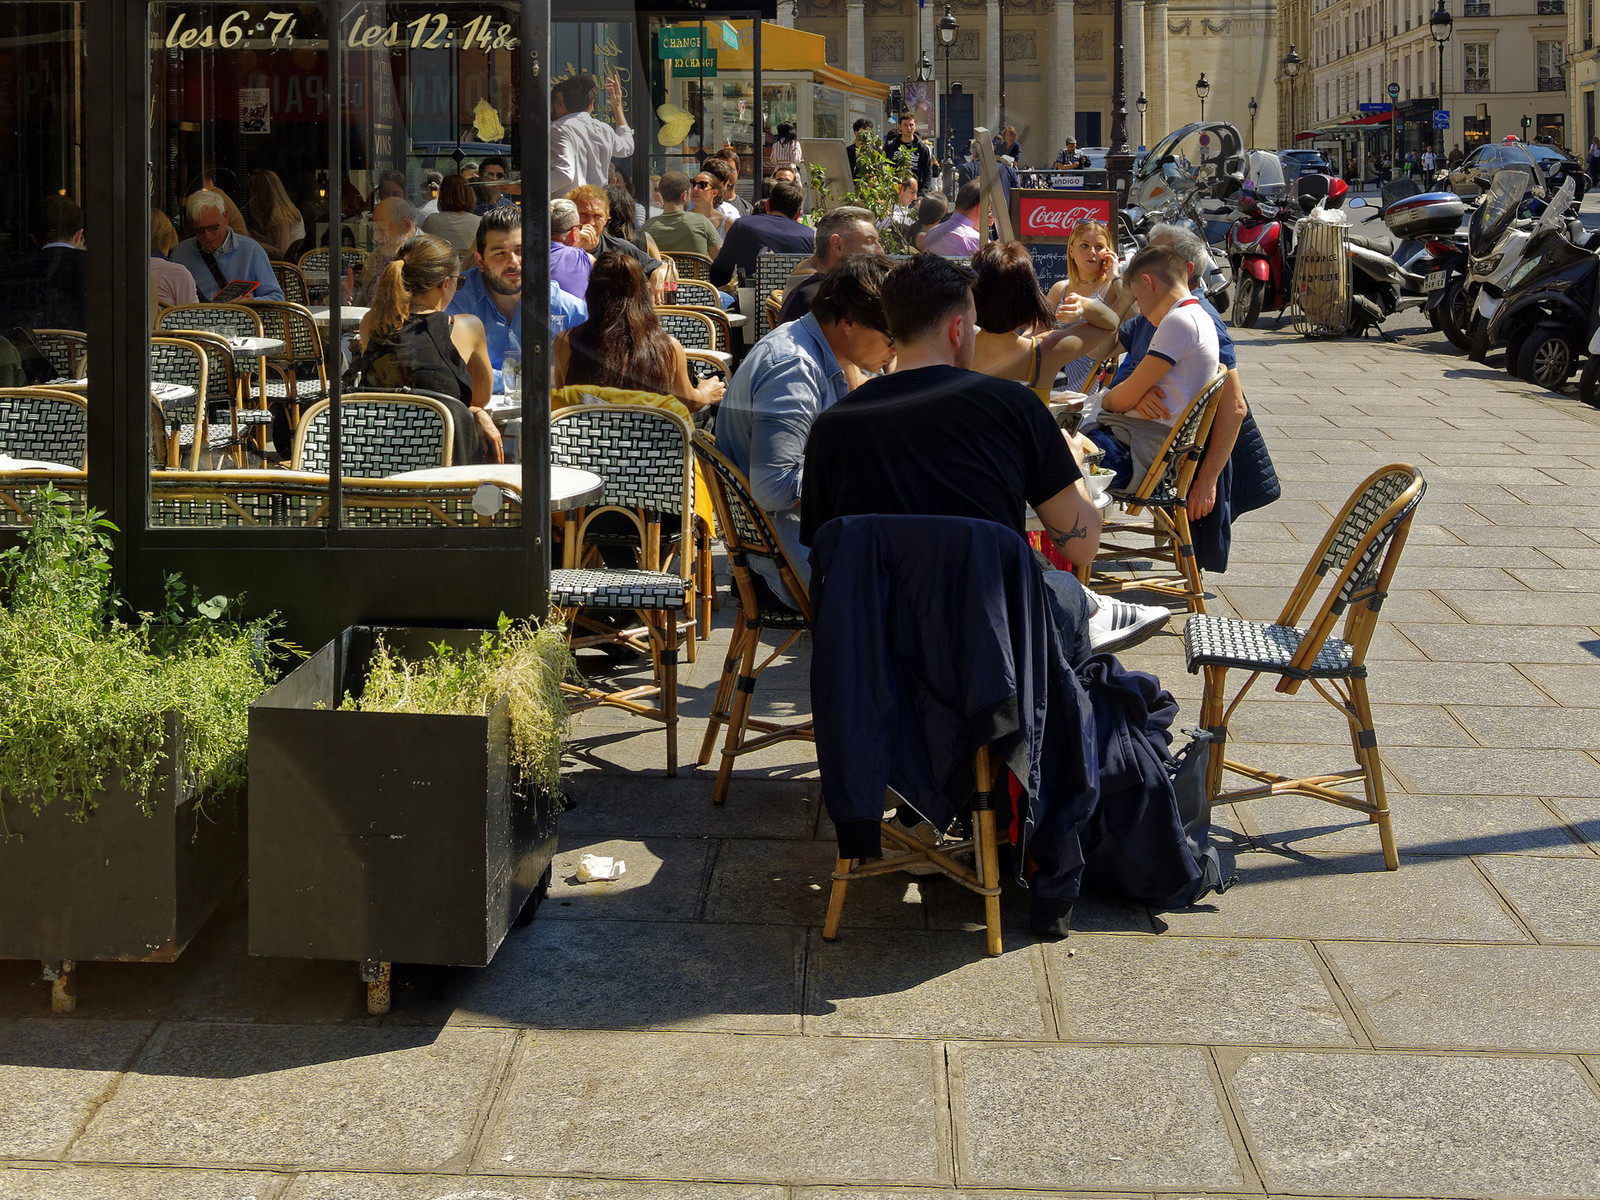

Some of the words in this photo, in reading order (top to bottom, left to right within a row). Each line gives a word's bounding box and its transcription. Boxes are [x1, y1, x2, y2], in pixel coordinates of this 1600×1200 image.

[165, 13, 213, 49] les
[348, 14, 399, 49] les
[374, 134, 392, 156] VINS
